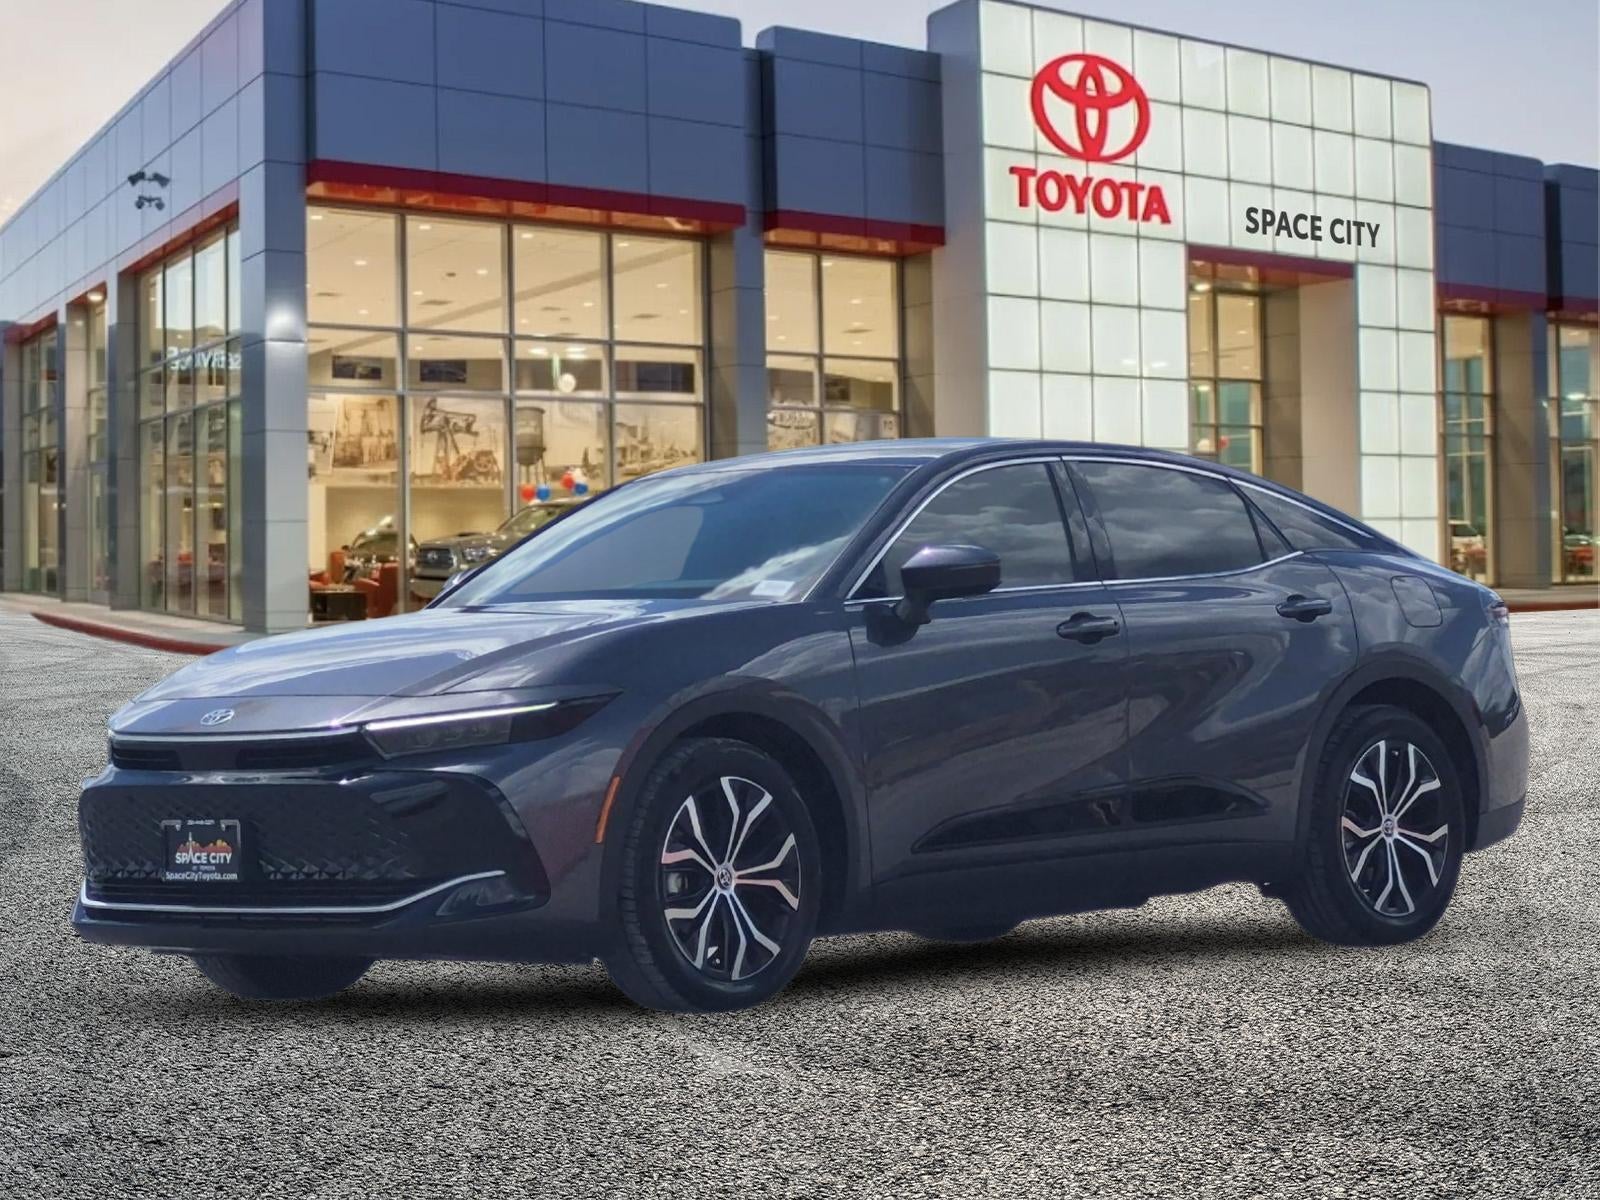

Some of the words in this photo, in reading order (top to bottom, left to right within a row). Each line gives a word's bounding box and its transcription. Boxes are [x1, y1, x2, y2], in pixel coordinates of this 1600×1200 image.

[1010, 166, 1171, 224] TOYOTA
[1245, 206, 1322, 241] SPACE
[1329, 218, 1381, 248] CITY
[175, 852, 207, 864] SPACE
[209, 852, 232, 864] CITY
[166, 872, 238, 881] SpaceCityToyota.com
